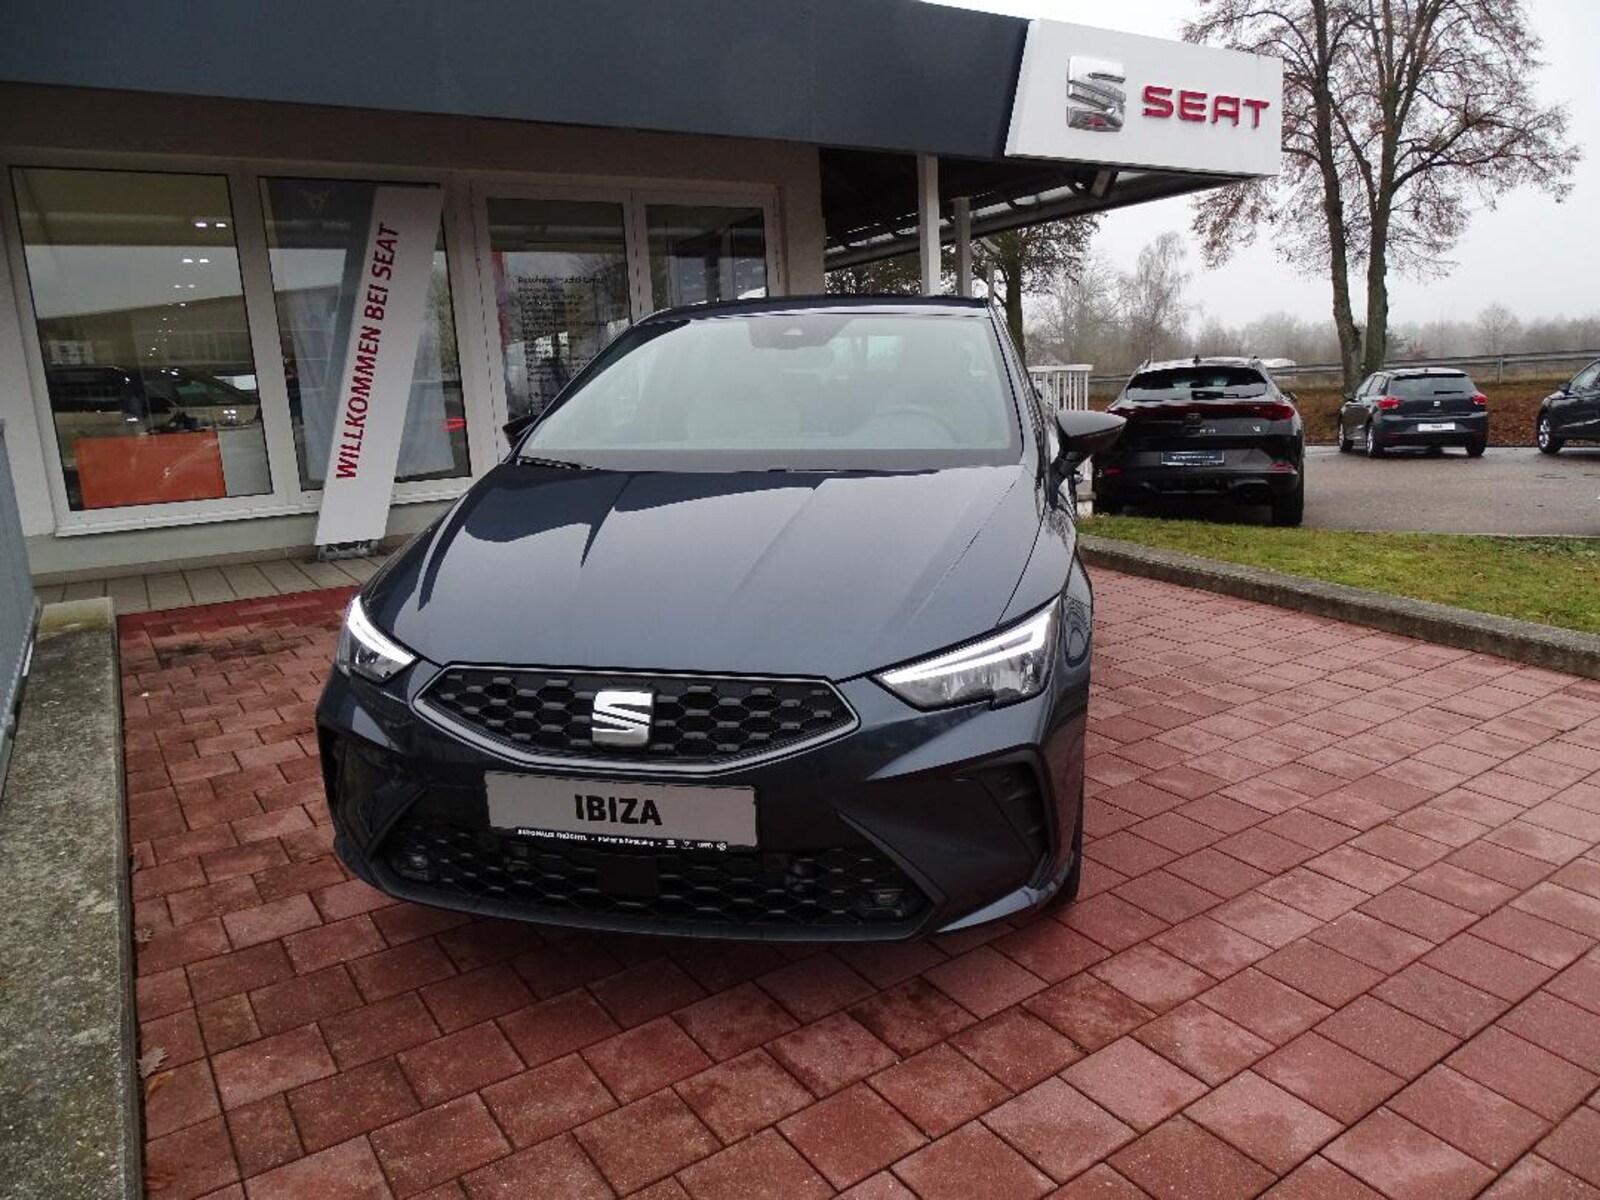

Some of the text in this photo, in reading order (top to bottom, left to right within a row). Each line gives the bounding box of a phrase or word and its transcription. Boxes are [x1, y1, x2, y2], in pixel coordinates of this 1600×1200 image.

[1142, 85, 1270, 130] SEAT
[336, 222, 400, 480] WILLKOMMEN BEI SEAT
[574, 794, 663, 826] IBIZA
